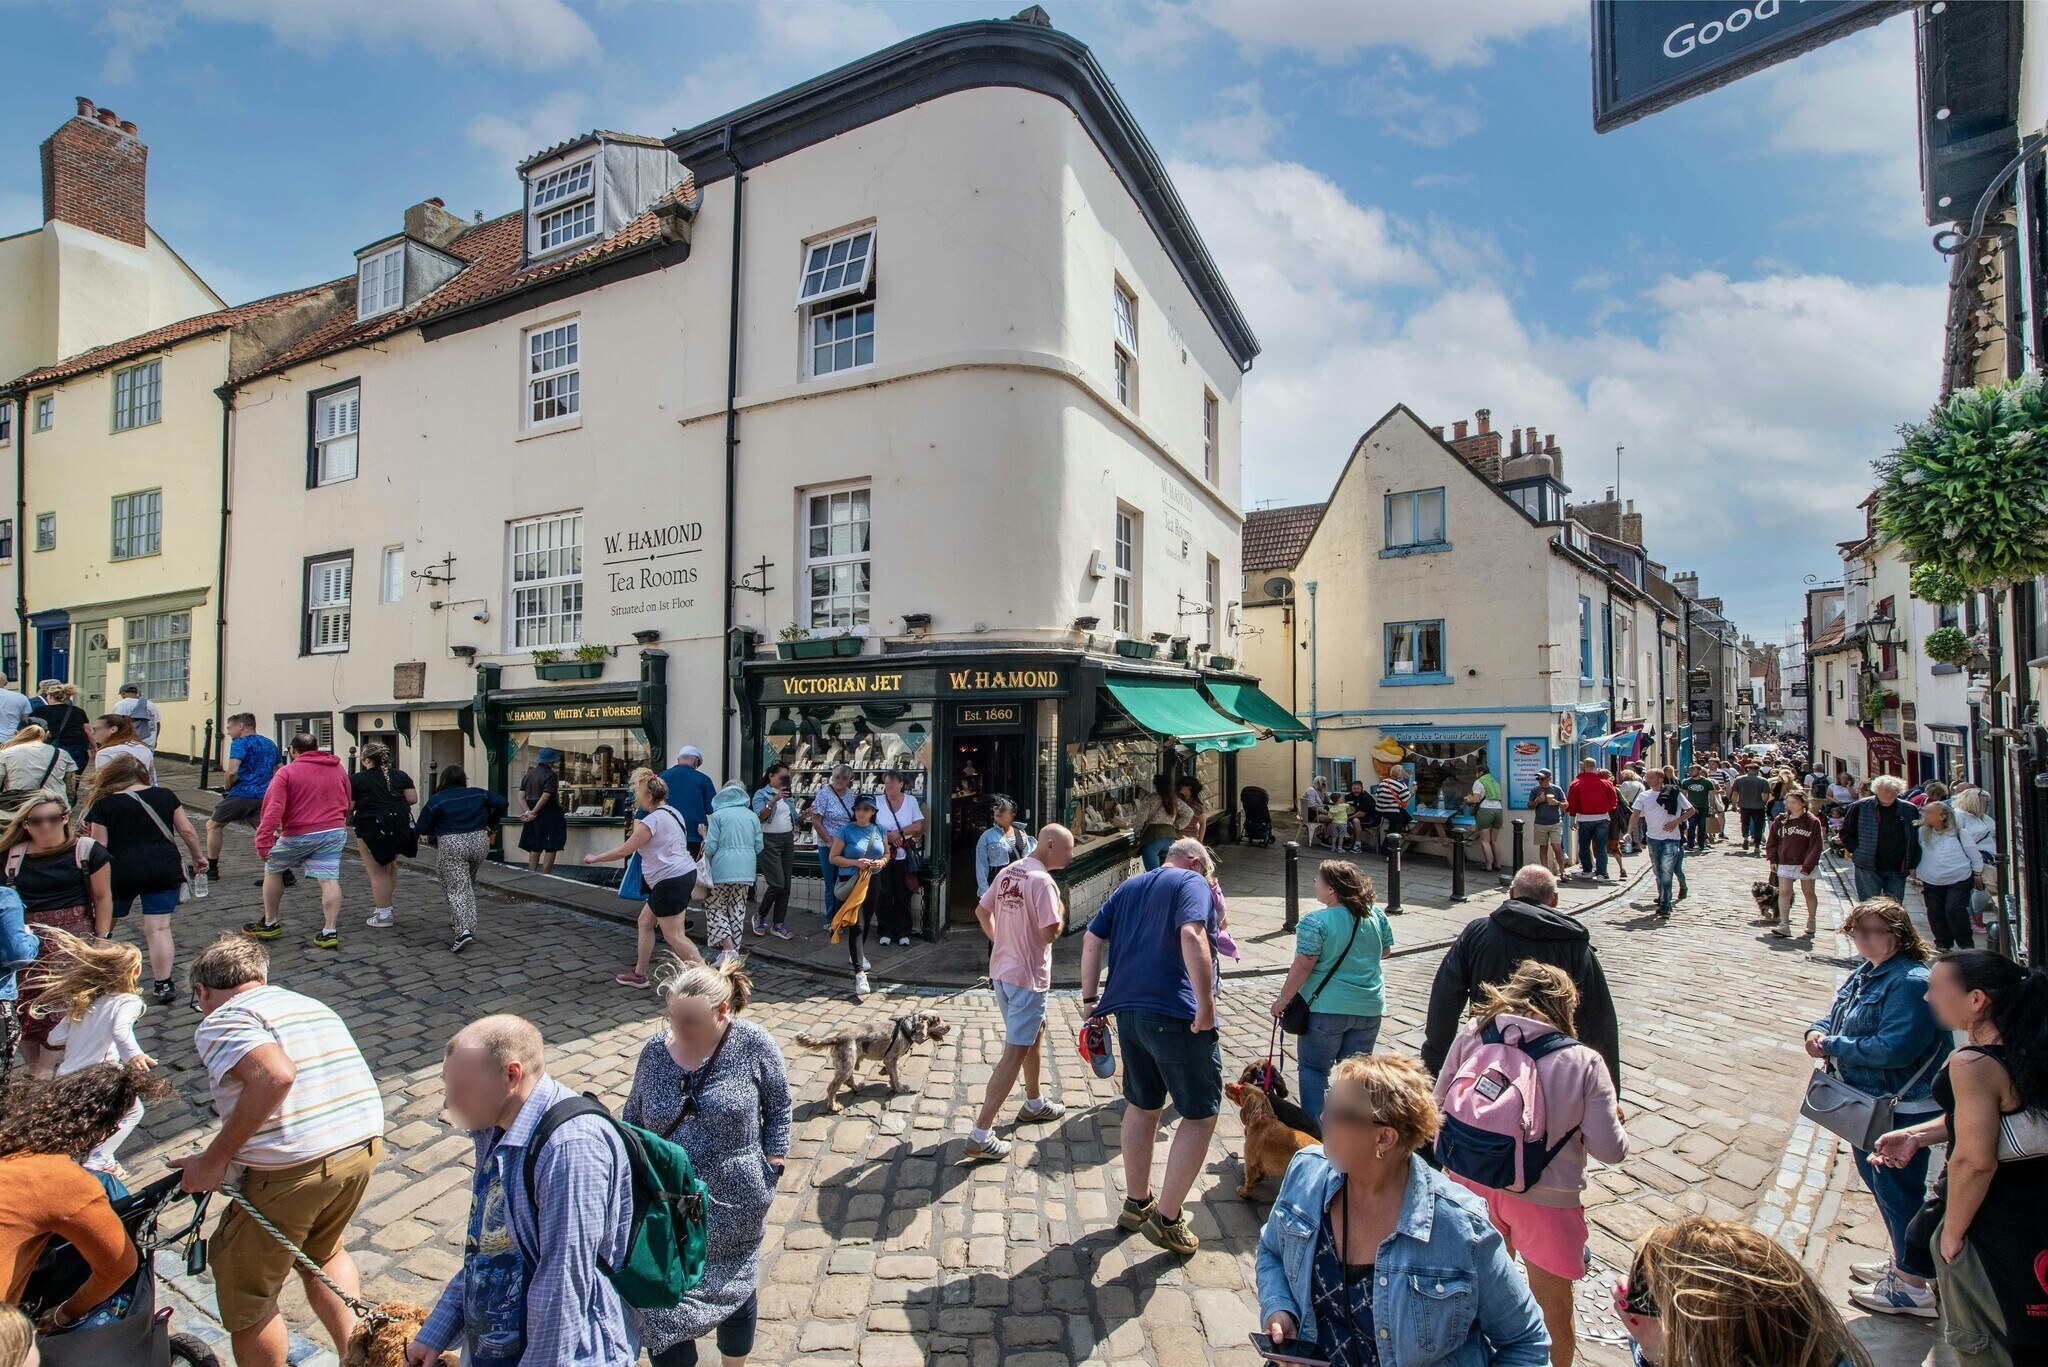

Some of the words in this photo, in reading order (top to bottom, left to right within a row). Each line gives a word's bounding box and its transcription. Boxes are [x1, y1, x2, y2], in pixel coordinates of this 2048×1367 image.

[604, 531, 622, 554] W.
[628, 522, 703, 551] HAMOND
[608, 572, 635, 593] Tea
[640, 567, 698, 589] Rooms
[611, 601, 644, 616] Situated
[646, 603, 657, 612] on
[672, 597, 695, 610] Floor
[783, 676, 867, 694] VICTORIAN
[870, 674, 902, 691] JET
[949, 669, 972, 690] W.
[975, 670, 1058, 689] HAMOND
[553, 706, 585, 720] WHITBY
[585, 707, 601, 718] JET
[602, 705, 642, 717] WORKSHO
[964, 710, 982, 721] Est.
[985, 707, 1013, 720] 1860
